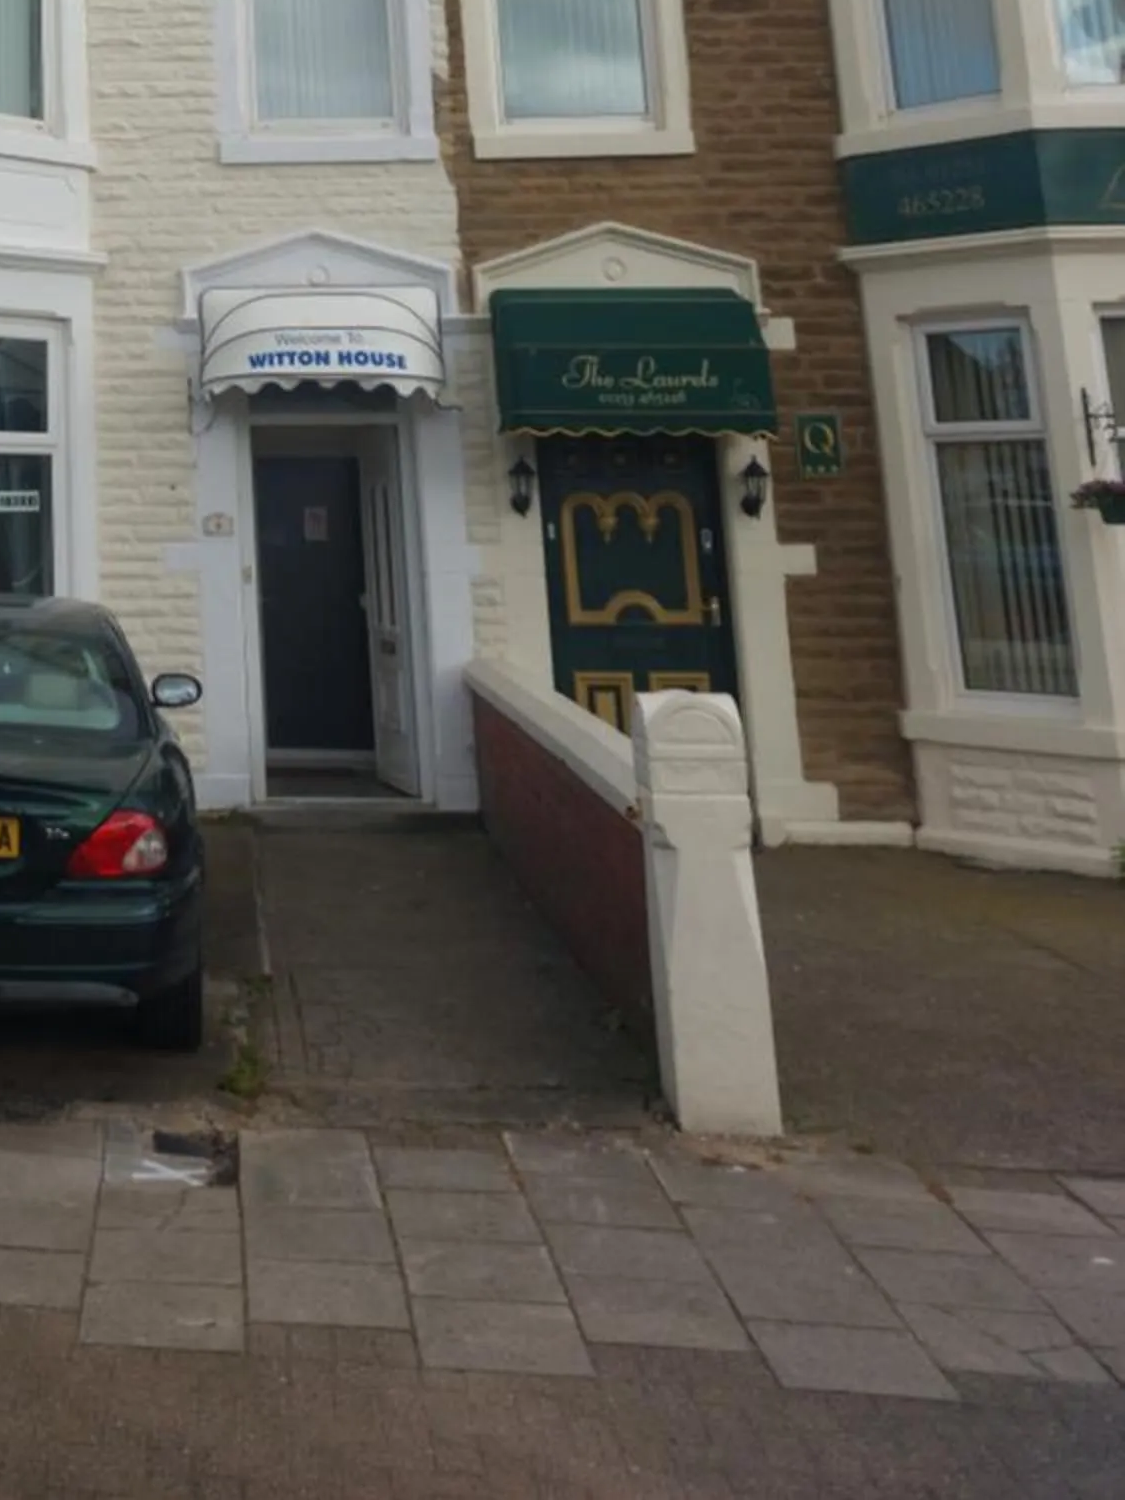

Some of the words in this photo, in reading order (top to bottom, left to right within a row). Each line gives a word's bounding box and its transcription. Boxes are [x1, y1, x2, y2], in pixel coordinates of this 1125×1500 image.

[248, 350, 331, 369] WITTON
[338, 350, 407, 369] HOUSE
[561, 355, 615, 388] The
[619, 355, 719, 388] Laurels
[803, 422, 836, 457] Q
